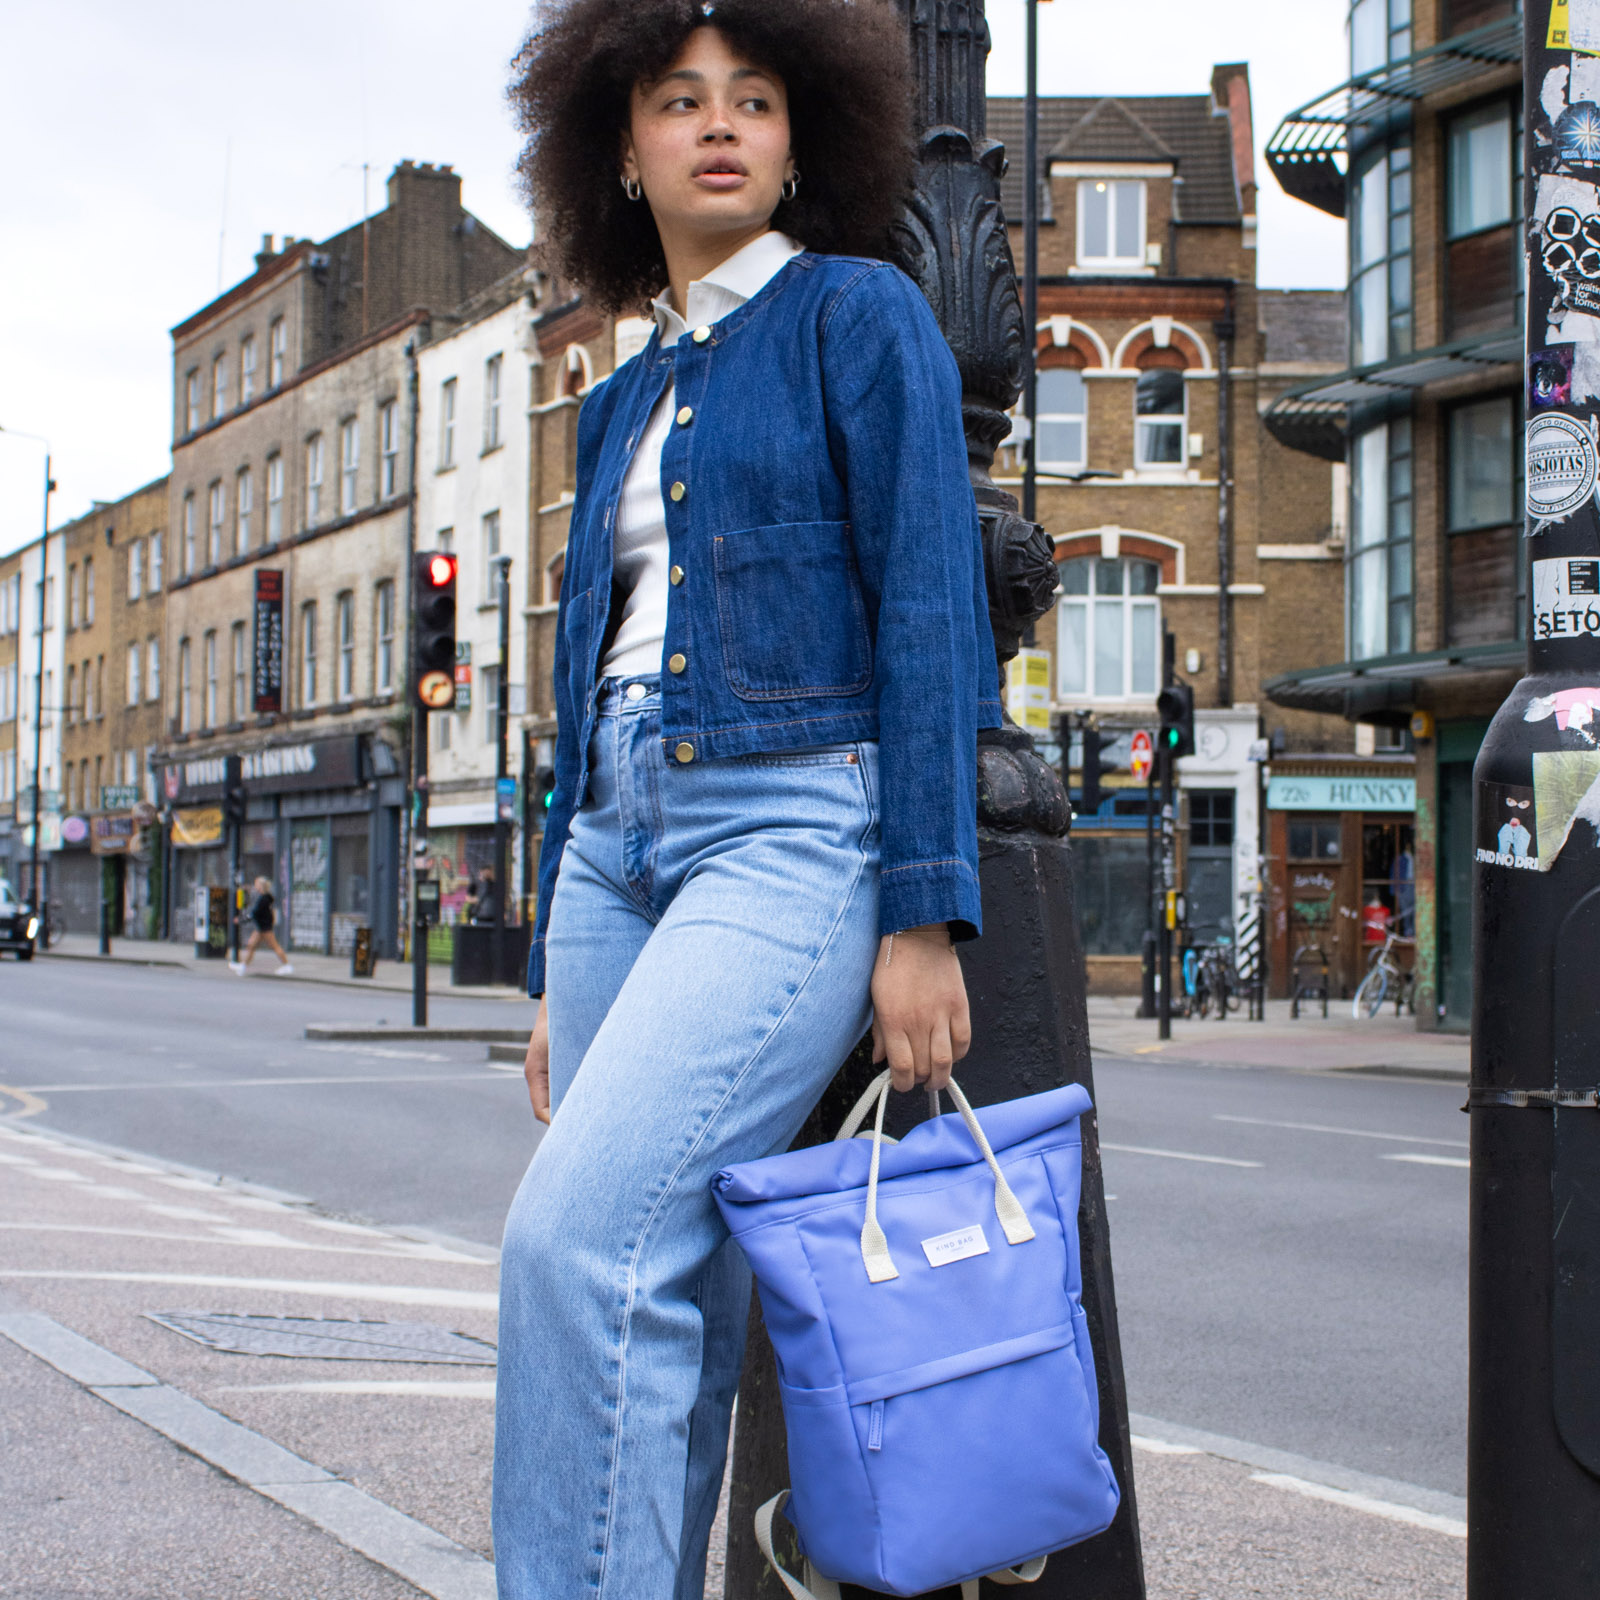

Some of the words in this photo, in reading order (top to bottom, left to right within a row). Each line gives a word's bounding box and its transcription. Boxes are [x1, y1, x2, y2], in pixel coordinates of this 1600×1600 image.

[1575, 289, 1590, 299] for
[1553, 419, 1582, 437] OFICIAL
[1529, 455, 1583, 476] OSJOTAS
[1581, 448, 1593, 490] PRODUCTO
[1556, 490, 1583, 510] OFICIAL
[105, 787, 137, 797] MINI
[1329, 783, 1412, 804] HUNKY
[1475, 848, 1496, 864] FIND
[1495, 852, 1514, 867] NO
[935, 1241, 955, 1252] KIND
[957, 1236, 974, 1246] BAG
